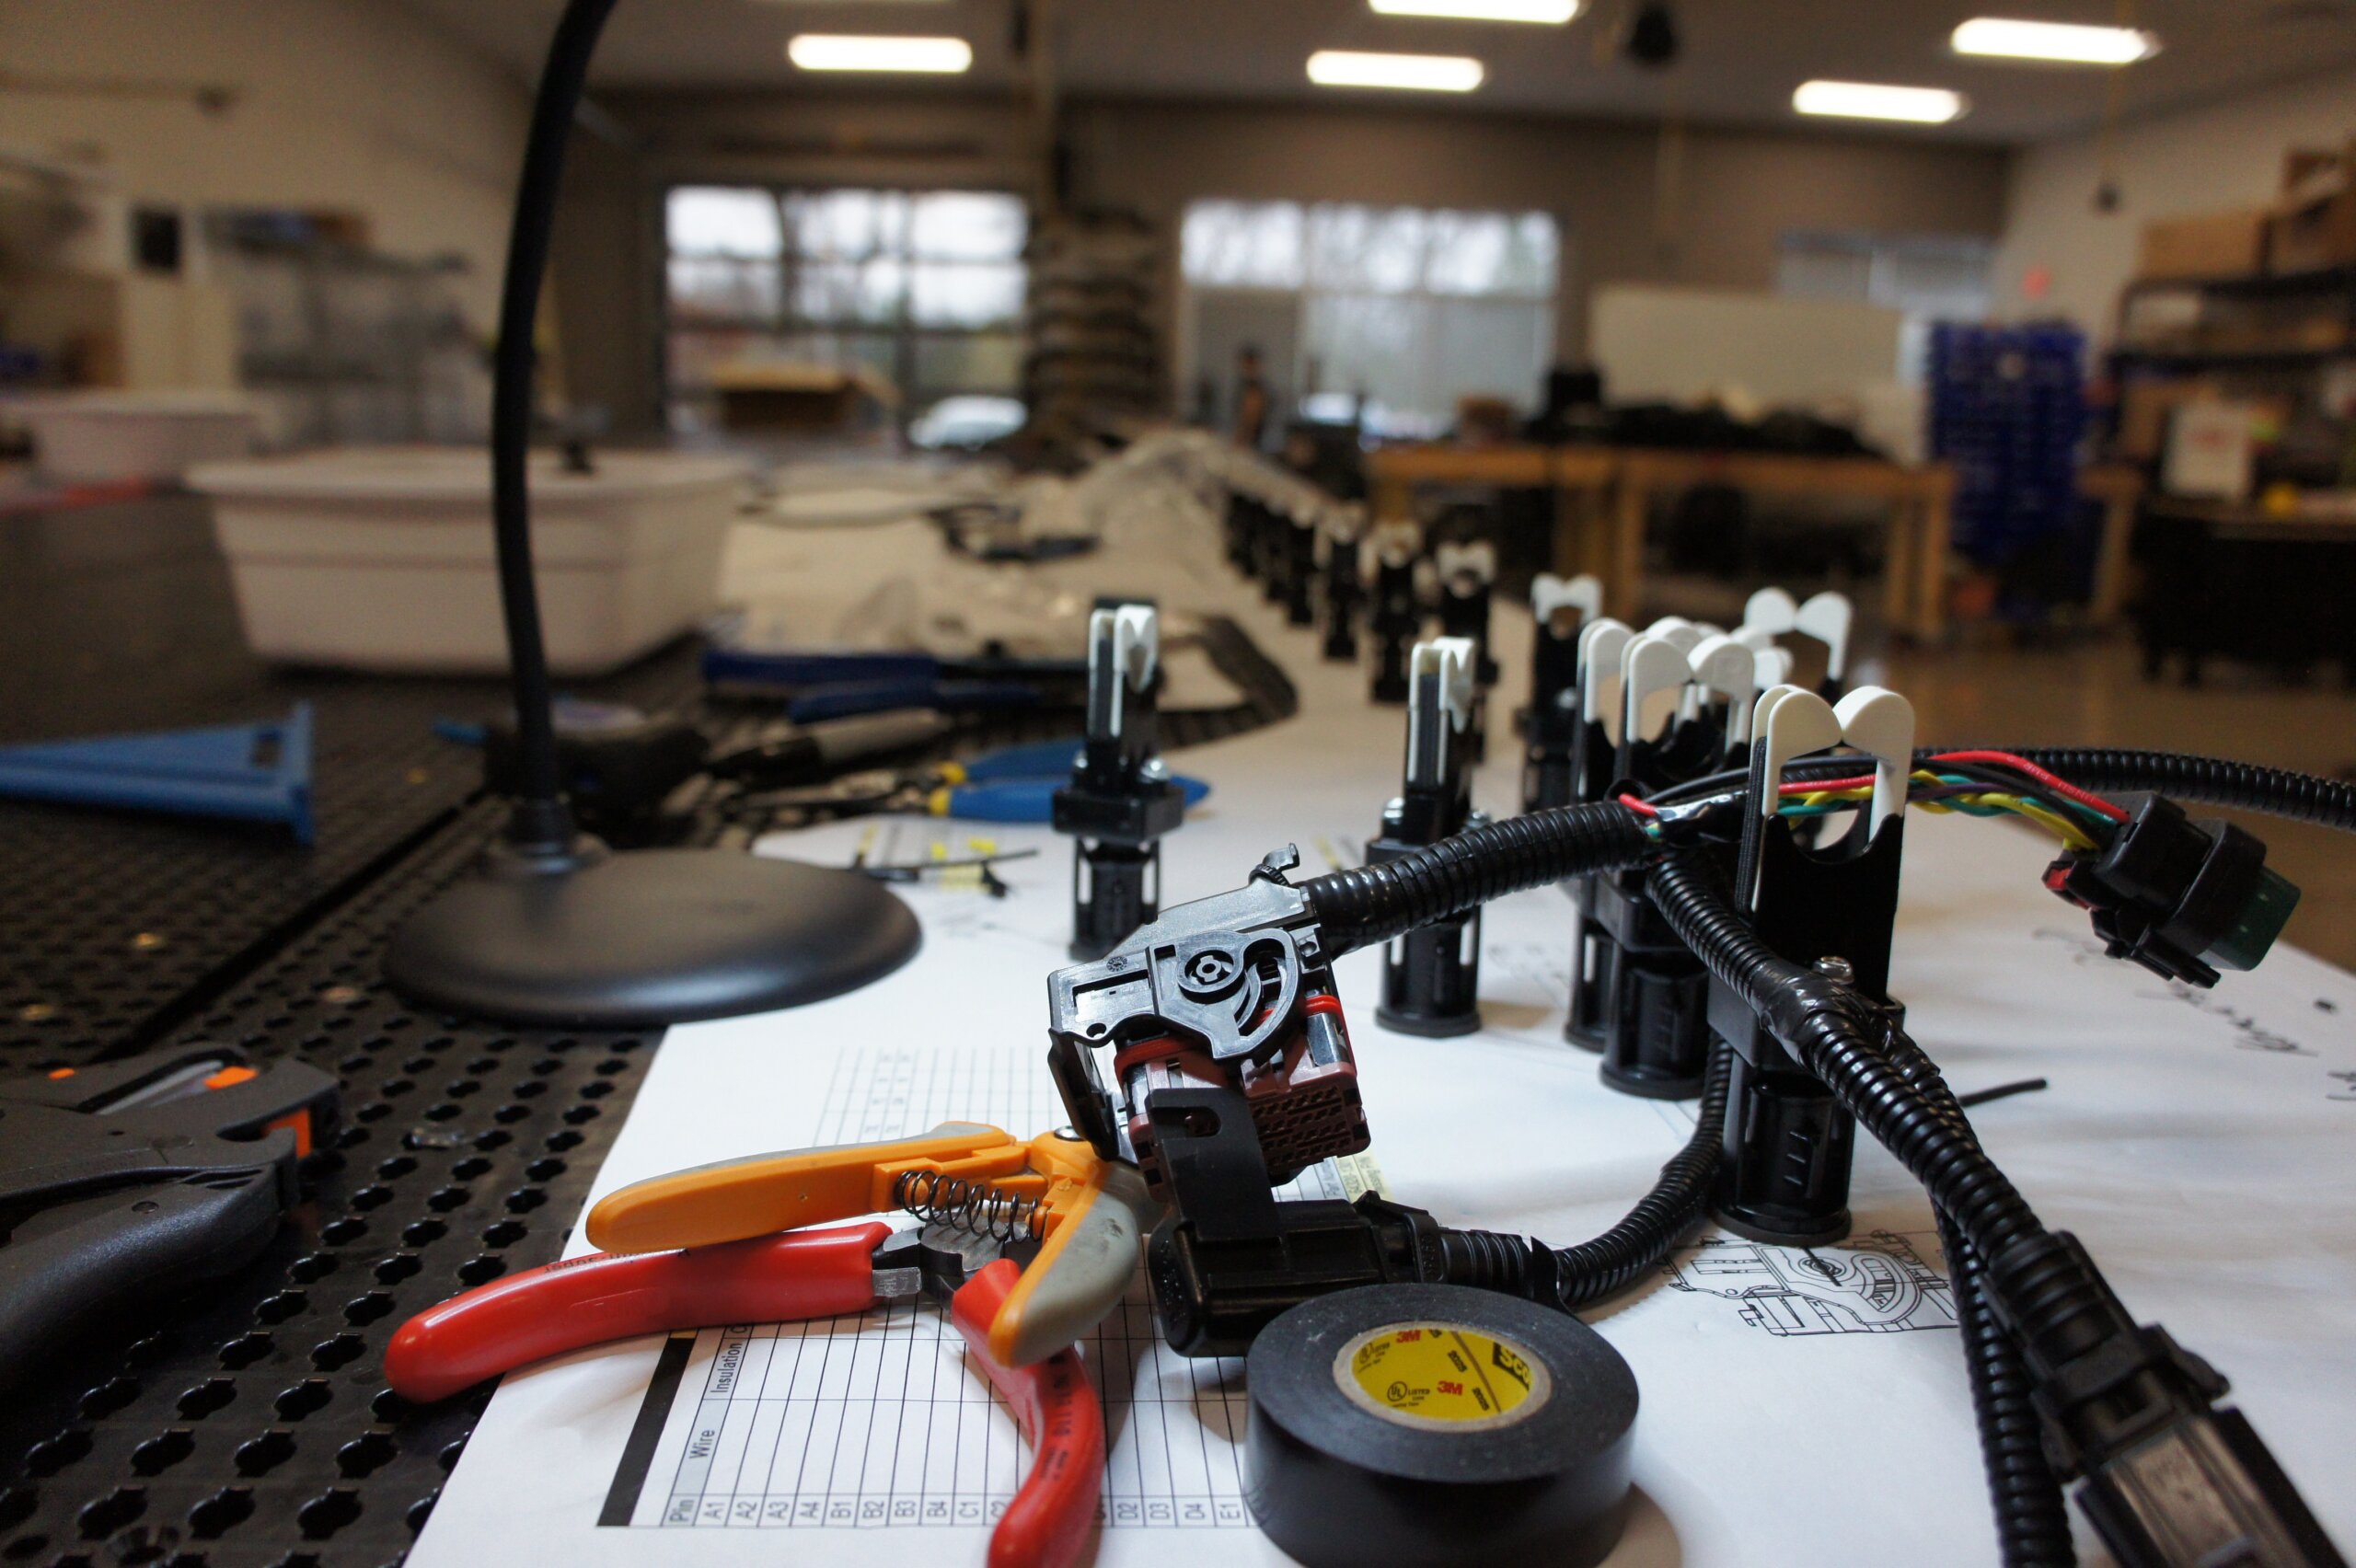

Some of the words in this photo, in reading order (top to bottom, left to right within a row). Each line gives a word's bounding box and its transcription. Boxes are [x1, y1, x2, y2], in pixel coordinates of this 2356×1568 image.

[1396, 1329, 1422, 1343] 3M
[1437, 1380, 1463, 1397] 3M
[669, 1498, 696, 1524] Pin
[688, 1429, 715, 1459] Wire
[710, 1343, 743, 1394] Insulation
[702, 1501, 726, 1518] A1
[735, 1500, 757, 1518] A2
[766, 1500, 790, 1518] A3
[797, 1501, 821, 1518] A4
[830, 1502, 852, 1518] B1
[862, 1500, 885, 1518] B2
[895, 1500, 917, 1518] B3
[926, 1500, 948, 1518] B4
[958, 1502, 980, 1518] C1
[1117, 1502, 1139, 1519] D2
[1149, 1502, 1171, 1519] D3
[1184, 1503, 1207, 1520] D4
[1219, 1503, 1241, 1520] E1
